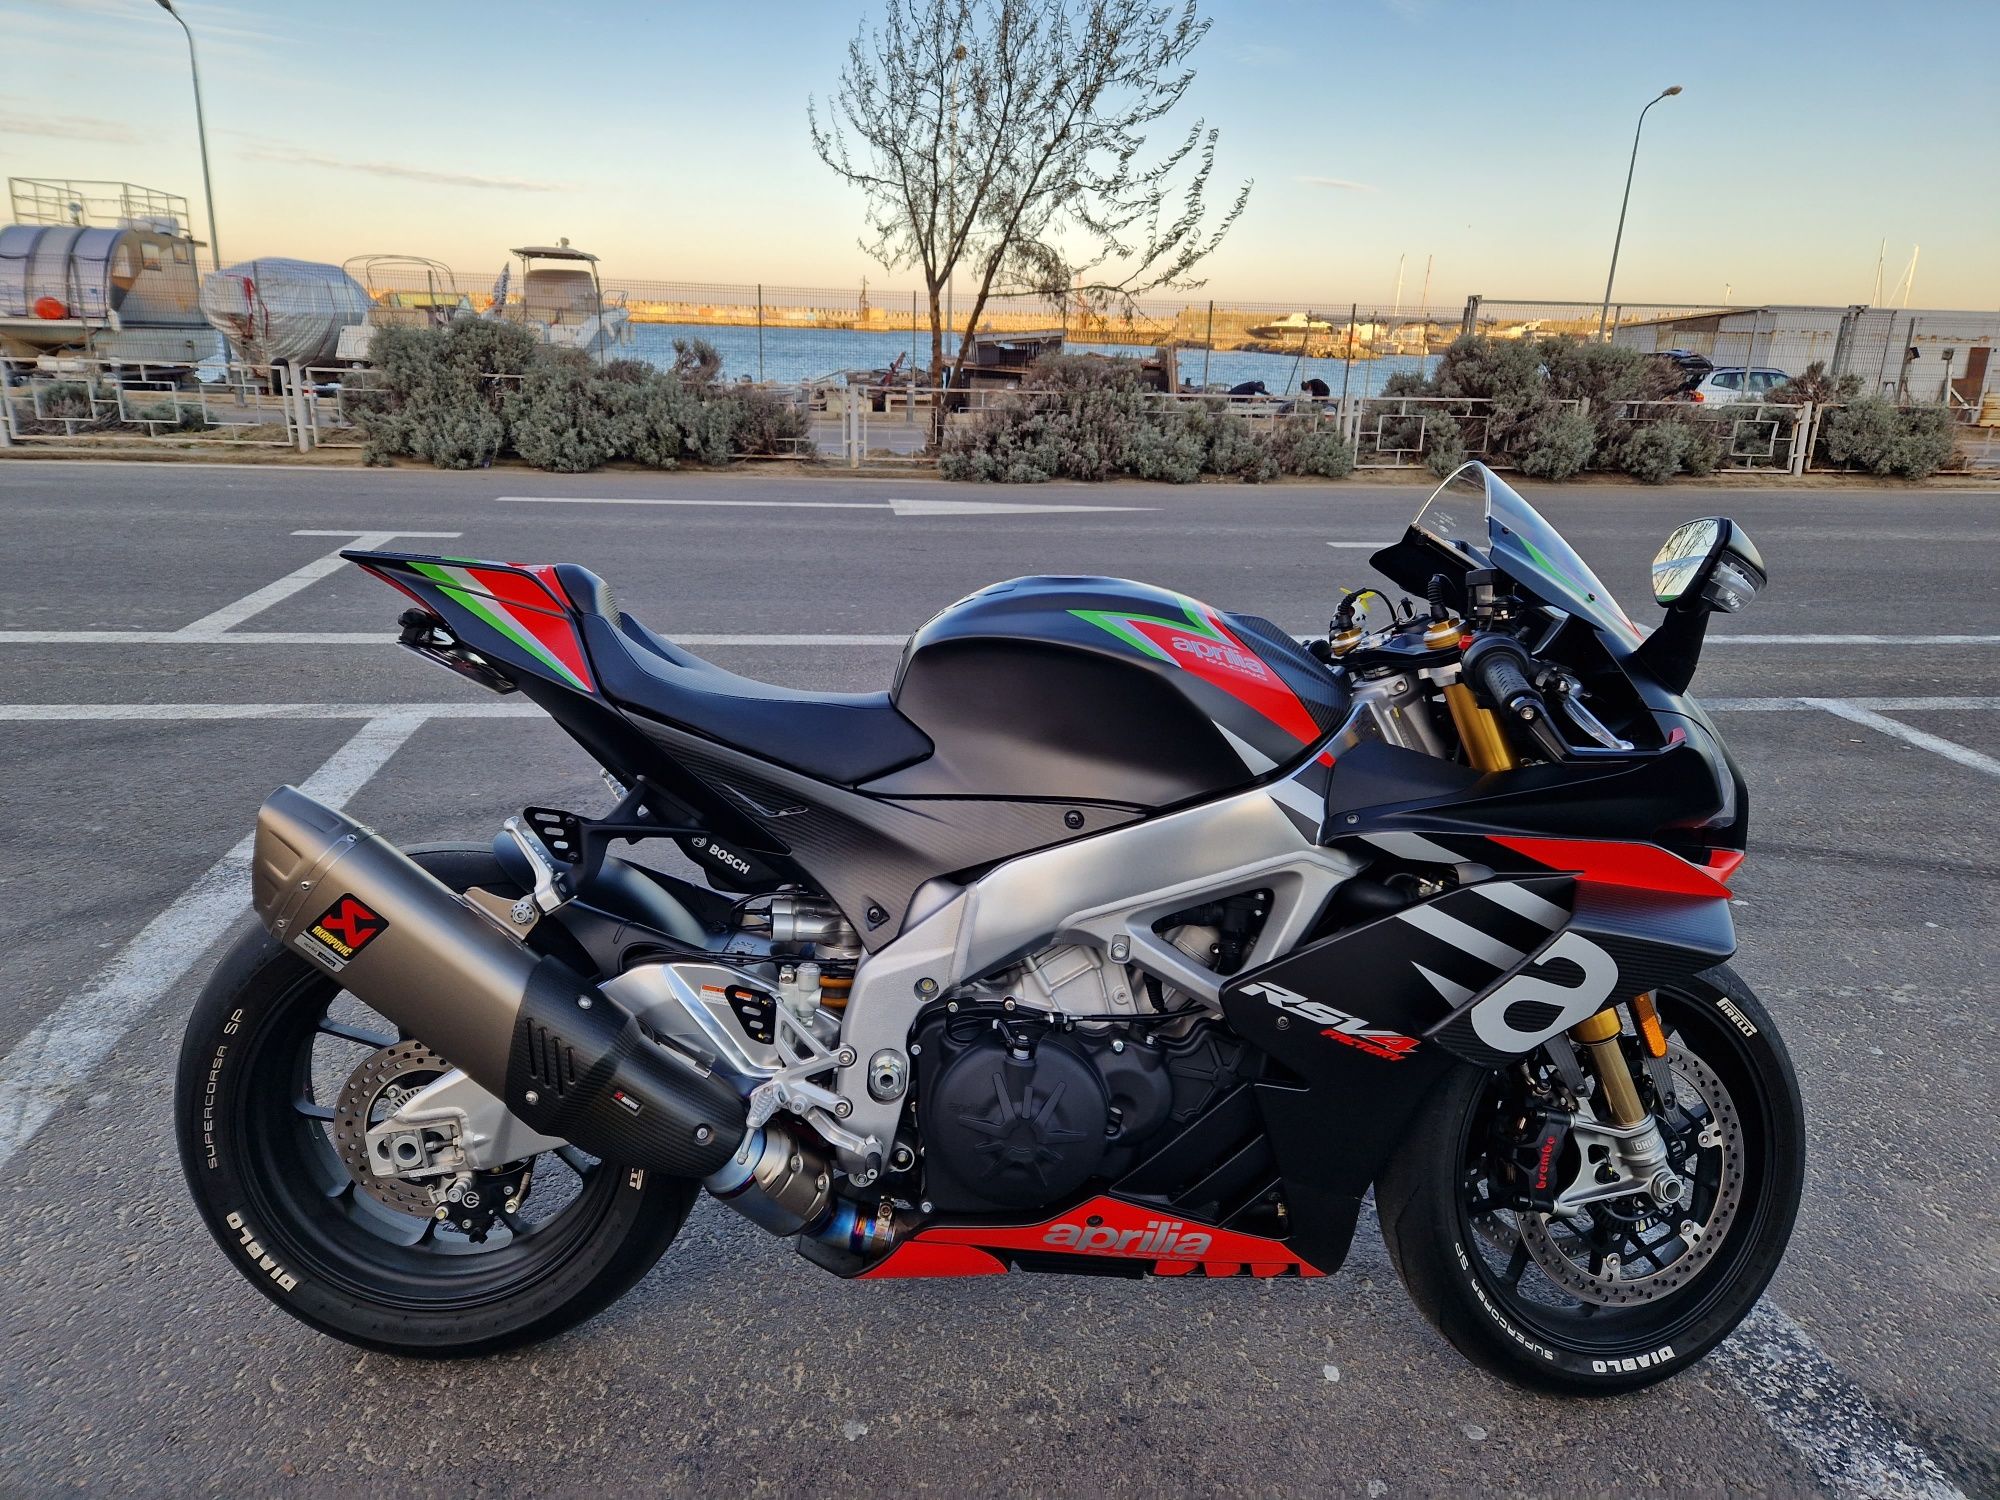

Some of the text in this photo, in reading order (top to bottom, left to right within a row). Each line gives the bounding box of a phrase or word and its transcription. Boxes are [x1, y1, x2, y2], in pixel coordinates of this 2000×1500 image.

[1171, 636, 1266, 676] aprilia
[708, 843, 751, 875] BOSCH
[1238, 981, 1422, 1053] RSV4
[1716, 997, 1758, 1037] PIRELLI
[203, 1008, 244, 1170] SUPERCORSA SP
[1535, 1135, 1557, 1190] brembo
[226, 1211, 299, 1293] DIABLO
[1042, 1220, 1213, 1255] aprilia
[1455, 1242, 1554, 1361] SUPERCORSA SP
[1592, 1345, 1676, 1373] DIABLO
